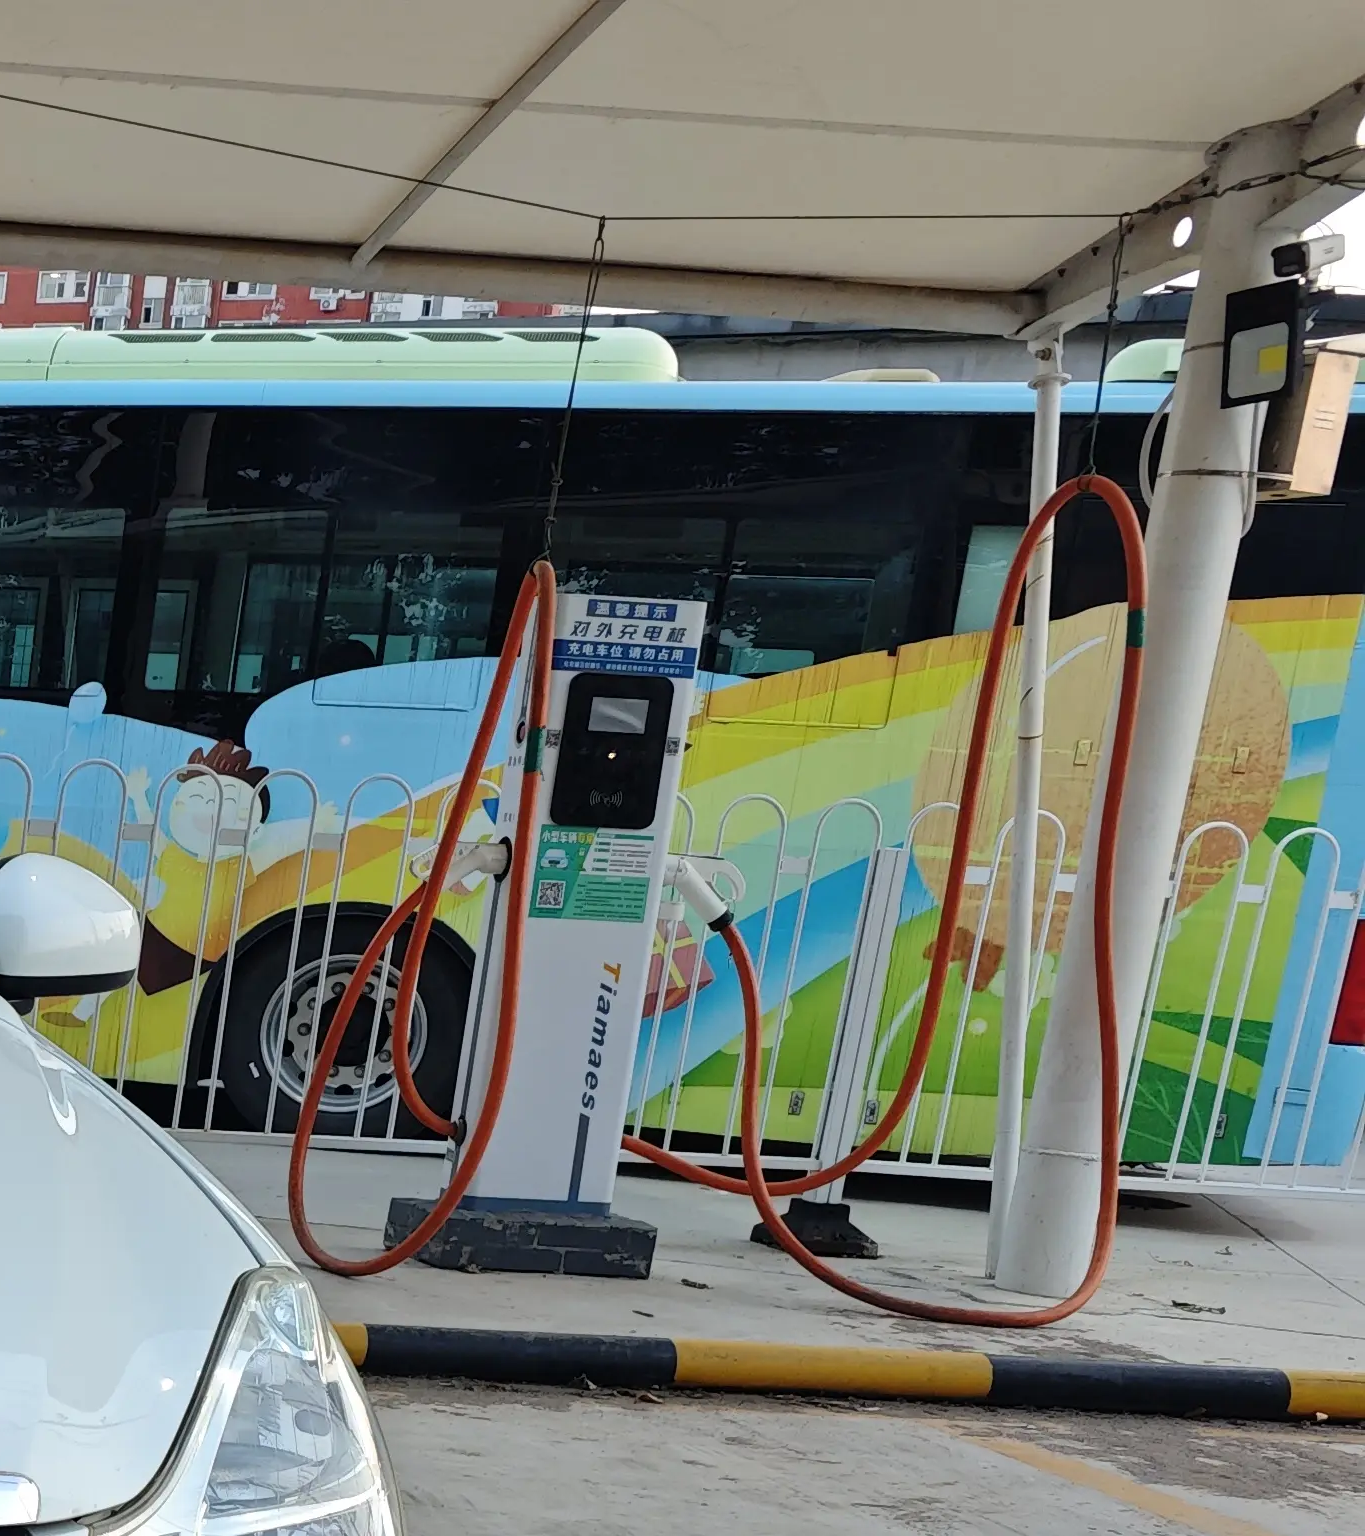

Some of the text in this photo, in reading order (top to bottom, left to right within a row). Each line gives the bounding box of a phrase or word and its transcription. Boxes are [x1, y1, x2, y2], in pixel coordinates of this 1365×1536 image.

[594, 601, 668, 619] 温馨提示
[569, 621, 687, 643] 对外充电桩
[567, 642, 684, 662] 充电车位 请勿占用
[581, 962, 622, 1111] Tiamaes
